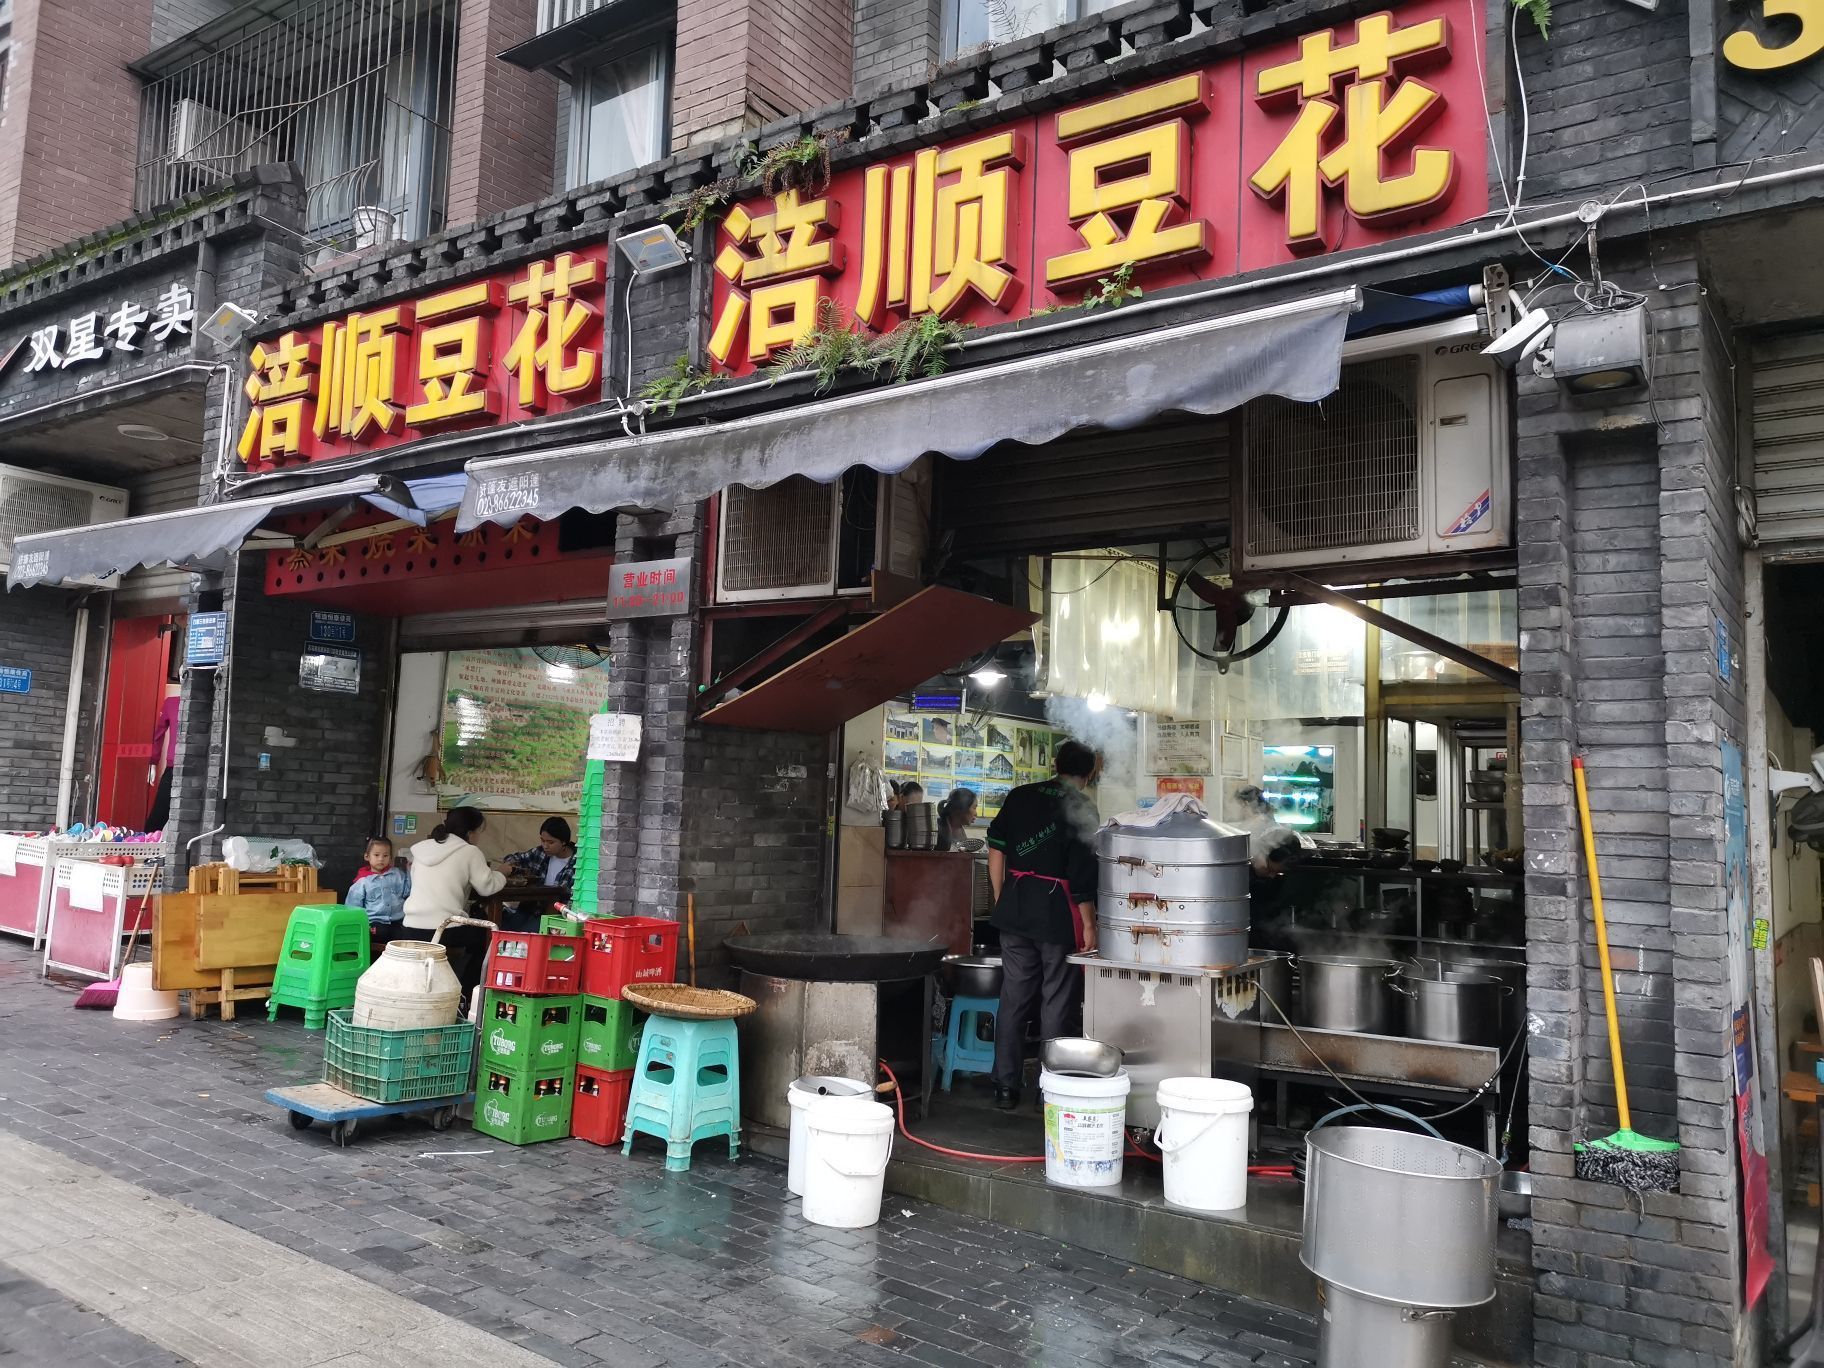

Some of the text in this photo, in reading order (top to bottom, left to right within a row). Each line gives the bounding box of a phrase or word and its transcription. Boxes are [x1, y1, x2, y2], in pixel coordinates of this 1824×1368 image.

[709, 12, 1455, 366] 涪顺豆花
[23, 283, 194, 373] 双星专卖
[237, 254, 598, 464] 涪顺豆花
[623, 568, 677, 589] 营业时间
[493, 1035, 517, 1052] TUBORG
